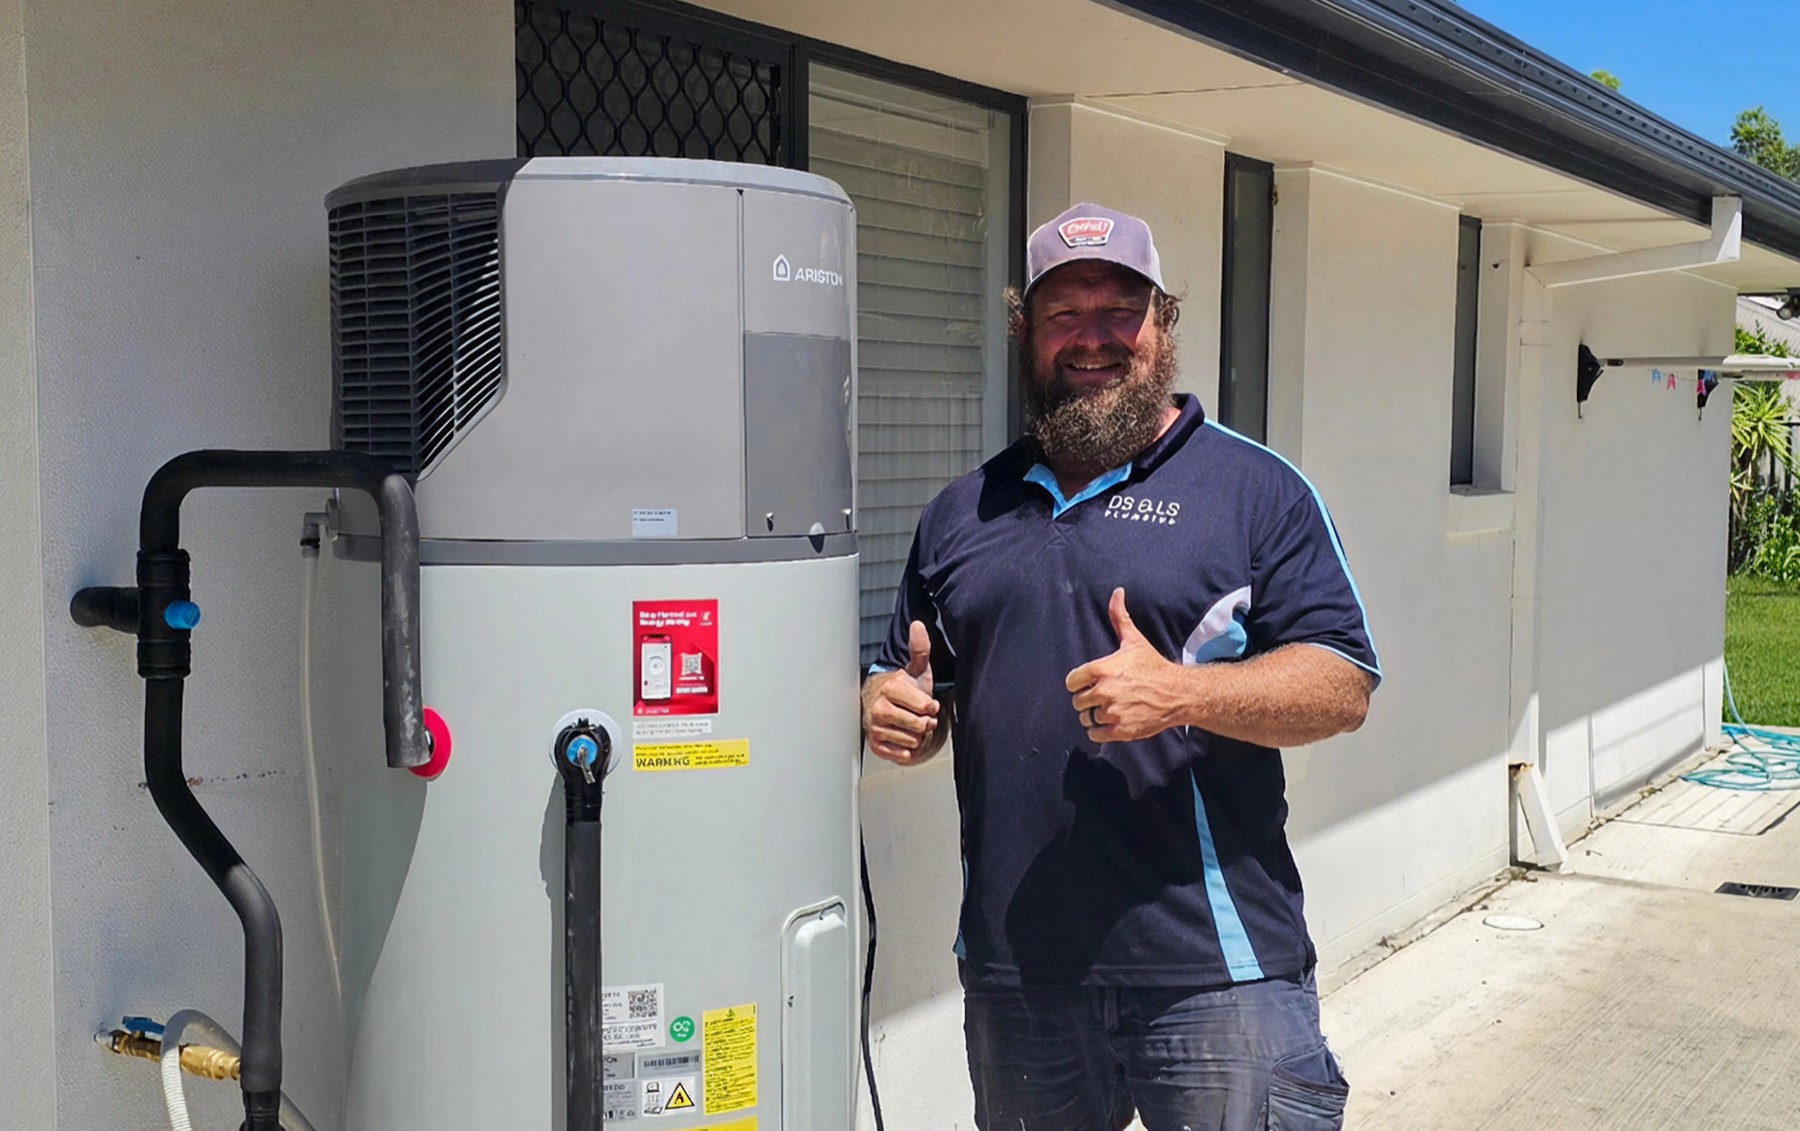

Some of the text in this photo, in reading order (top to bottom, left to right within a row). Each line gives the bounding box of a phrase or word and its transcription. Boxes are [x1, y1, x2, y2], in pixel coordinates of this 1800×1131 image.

[1108, 495, 1135, 511] DS
[1156, 500, 1180, 517] LS
[636, 756, 690, 768] WARNING
